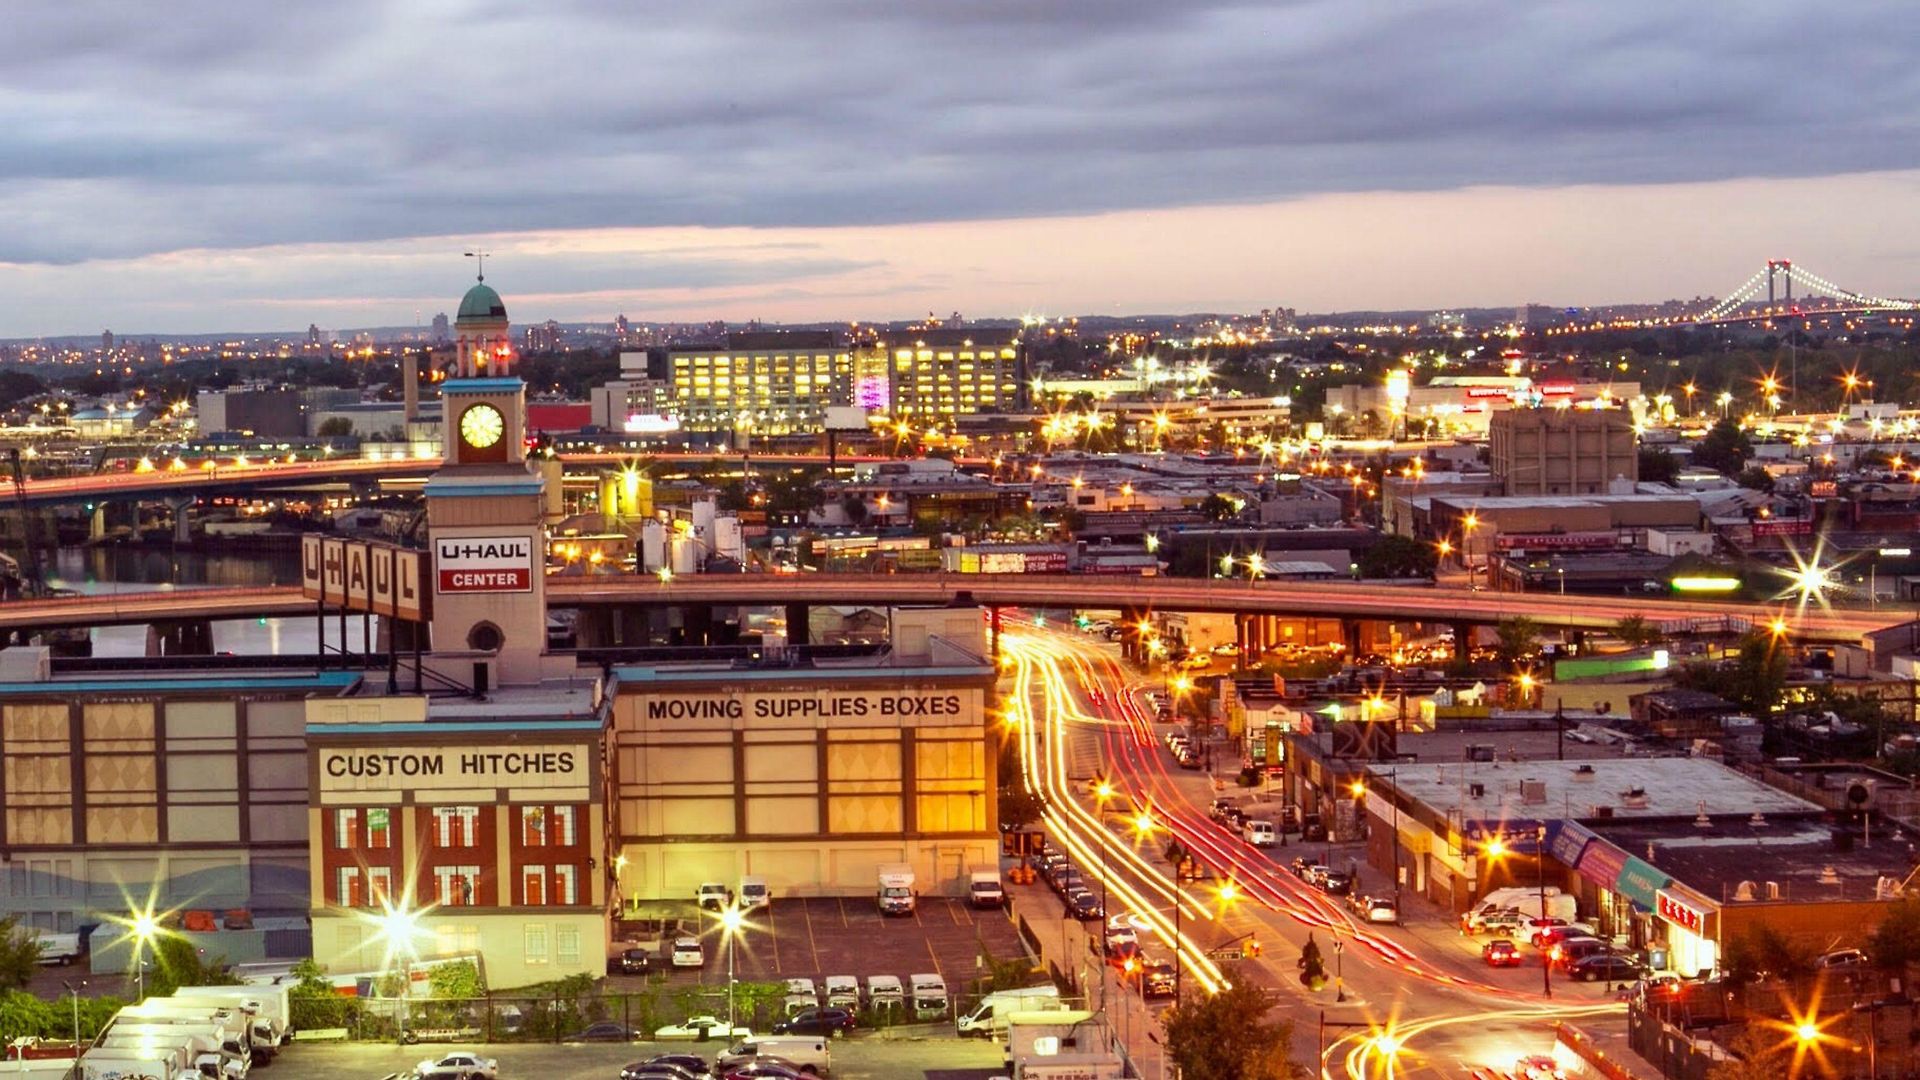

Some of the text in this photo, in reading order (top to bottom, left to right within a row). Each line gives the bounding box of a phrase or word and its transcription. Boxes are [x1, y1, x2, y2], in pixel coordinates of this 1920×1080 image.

[442, 543, 527, 559] U-HAUL
[452, 573, 518, 587] CENTER
[648, 699, 743, 719] MOVING
[327, 751, 574, 777] CUSTOM HITCHES
